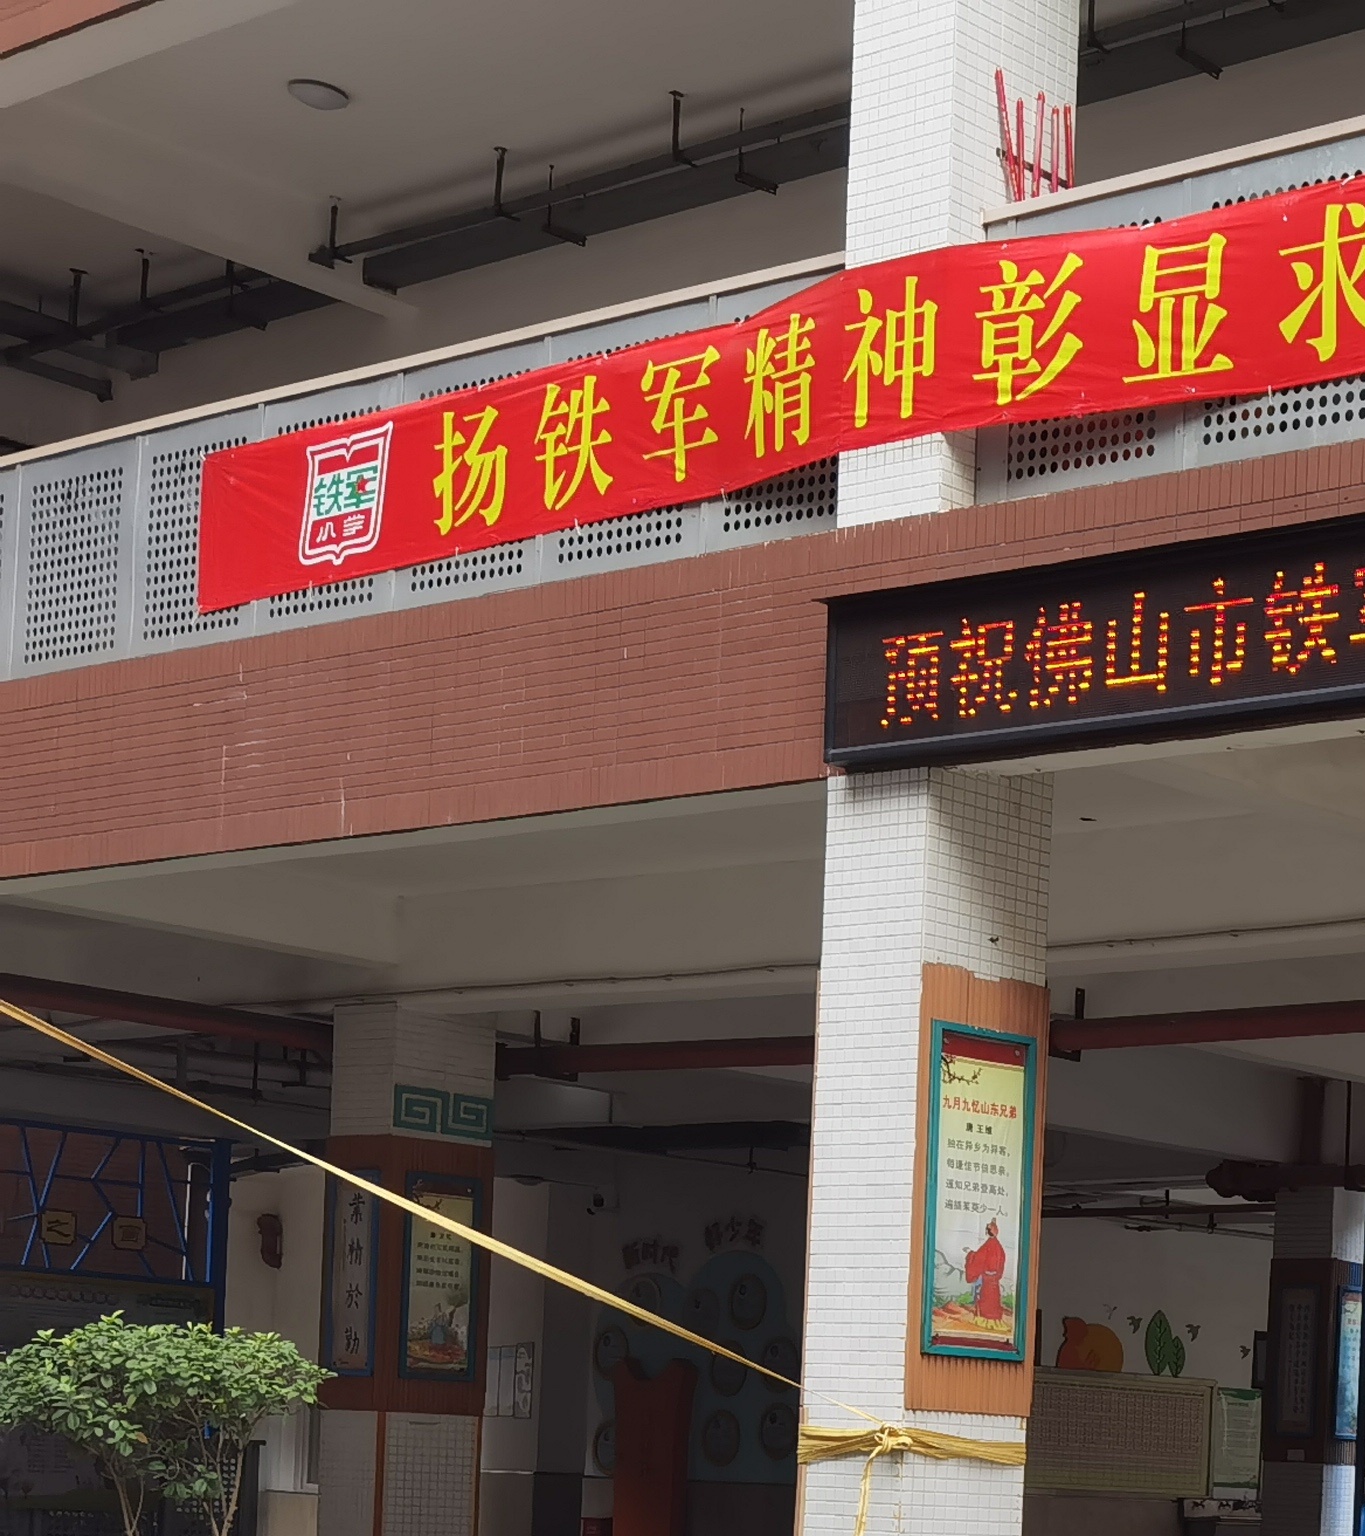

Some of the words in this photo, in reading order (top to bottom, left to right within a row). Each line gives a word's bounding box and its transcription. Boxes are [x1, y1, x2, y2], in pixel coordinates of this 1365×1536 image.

[313, 466, 378, 516] 铁军
[943, 1095, 1018, 1119] 九月九忆山东兄弟
